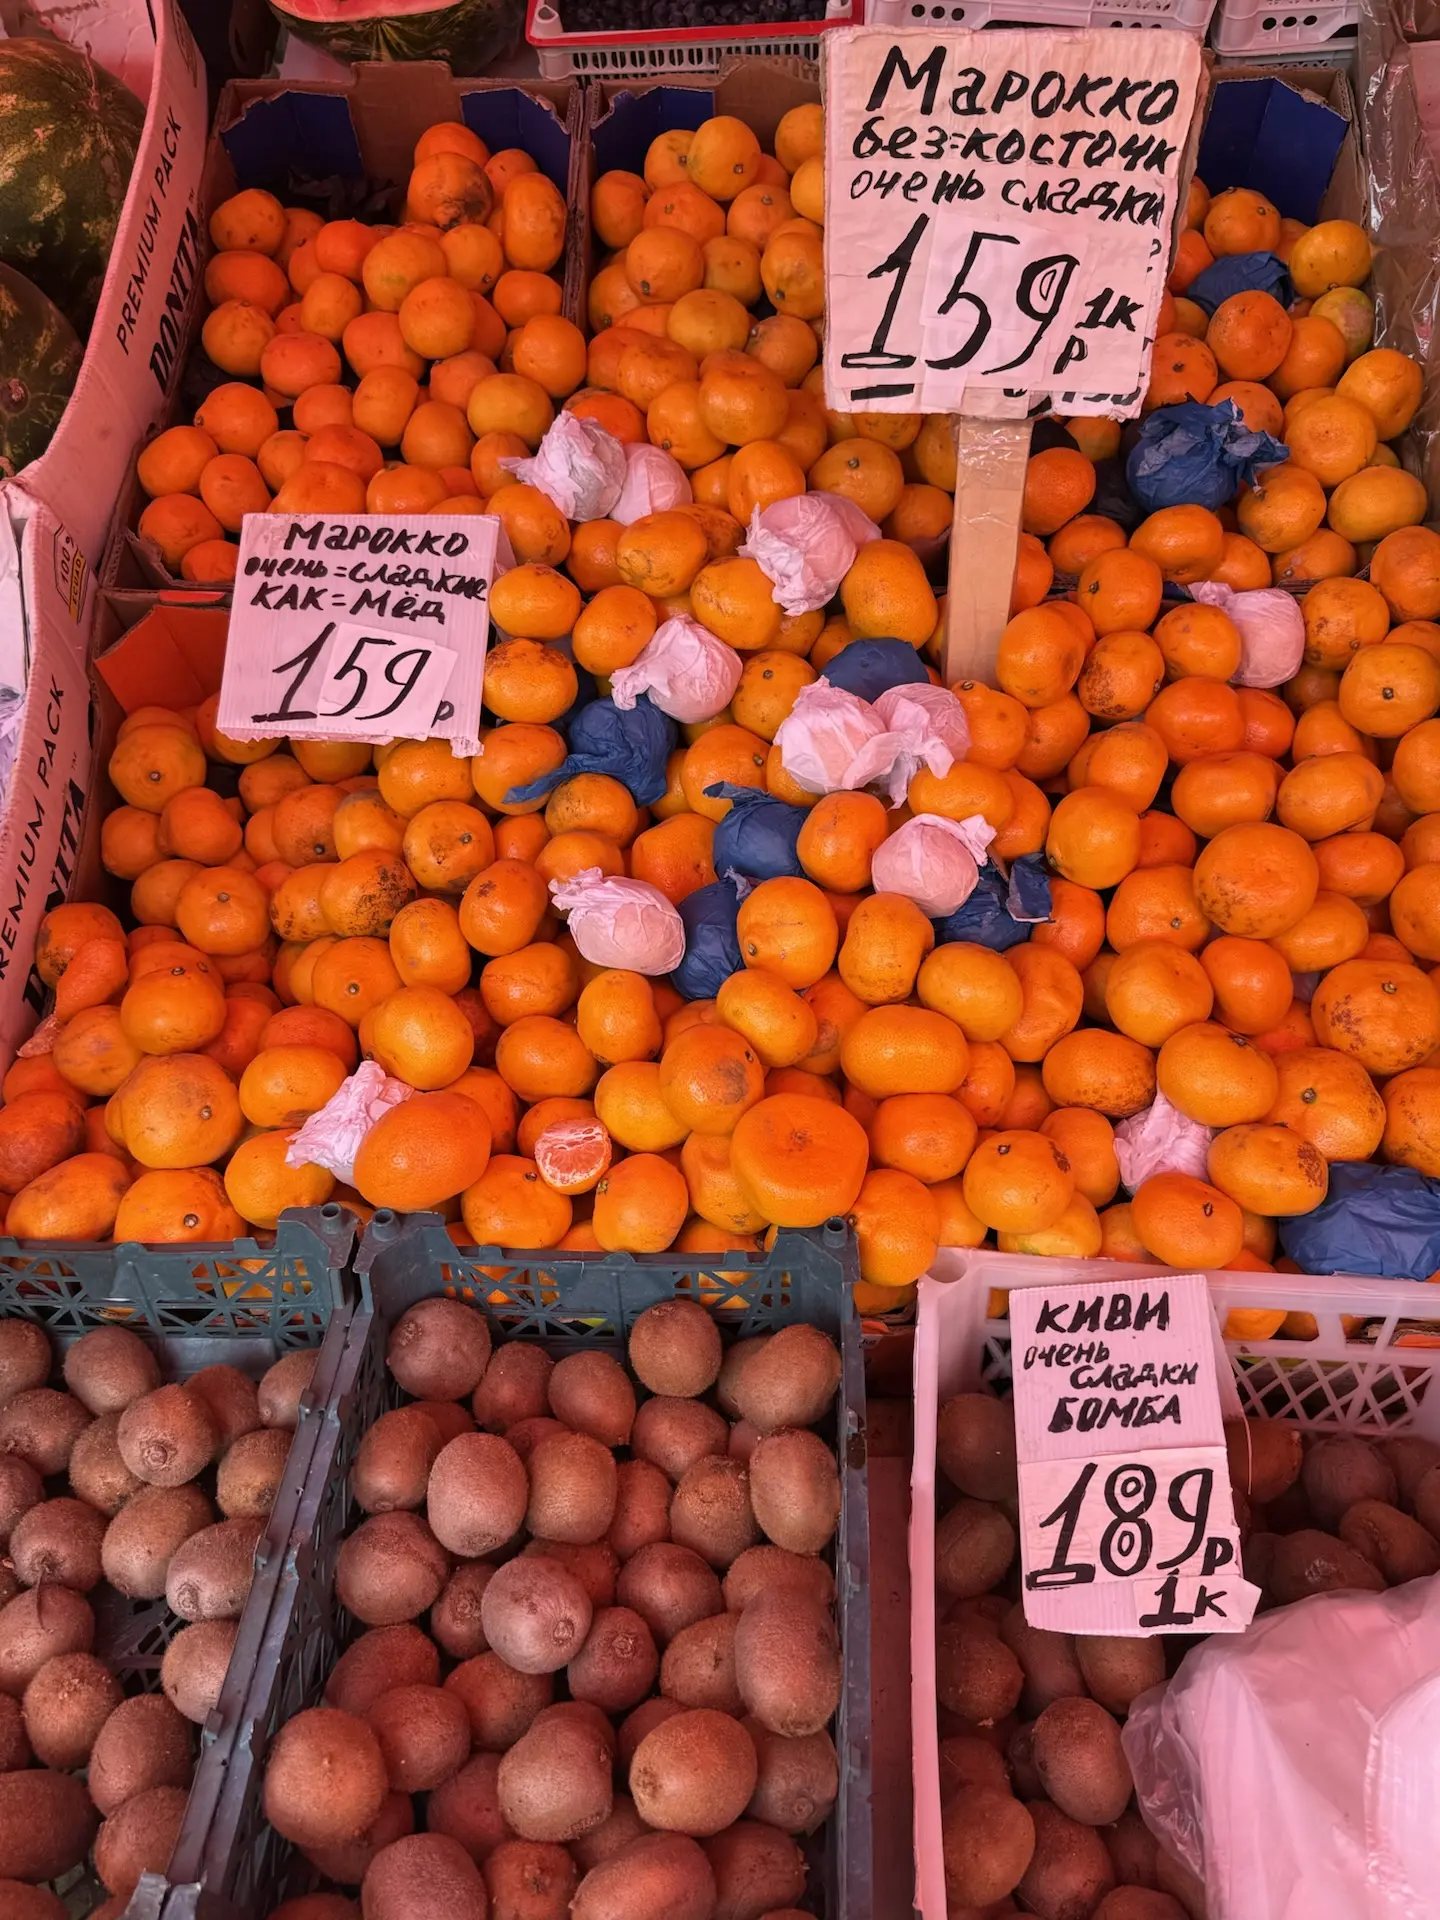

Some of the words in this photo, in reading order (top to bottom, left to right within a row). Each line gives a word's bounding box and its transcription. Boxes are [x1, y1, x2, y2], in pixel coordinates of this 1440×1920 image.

[865, 45, 1180, 125] Марокко
[116, 196, 162, 356] PREMIUM
[154, 105, 182, 198] PACK
[850, 169, 985, 204] очень
[841, 213, 1081, 376] 159
[251, 622, 432, 723] 159
[0, 795, 45, 981] REMIUM
[37, 674, 65, 790] PACK
[1023, 1341, 1110, 1370] очень
[1035, 1291, 1170, 1333] КИВИ
[1047, 1394, 1182, 1433] БОМБА
[1025, 1462, 1214, 1590] 189
